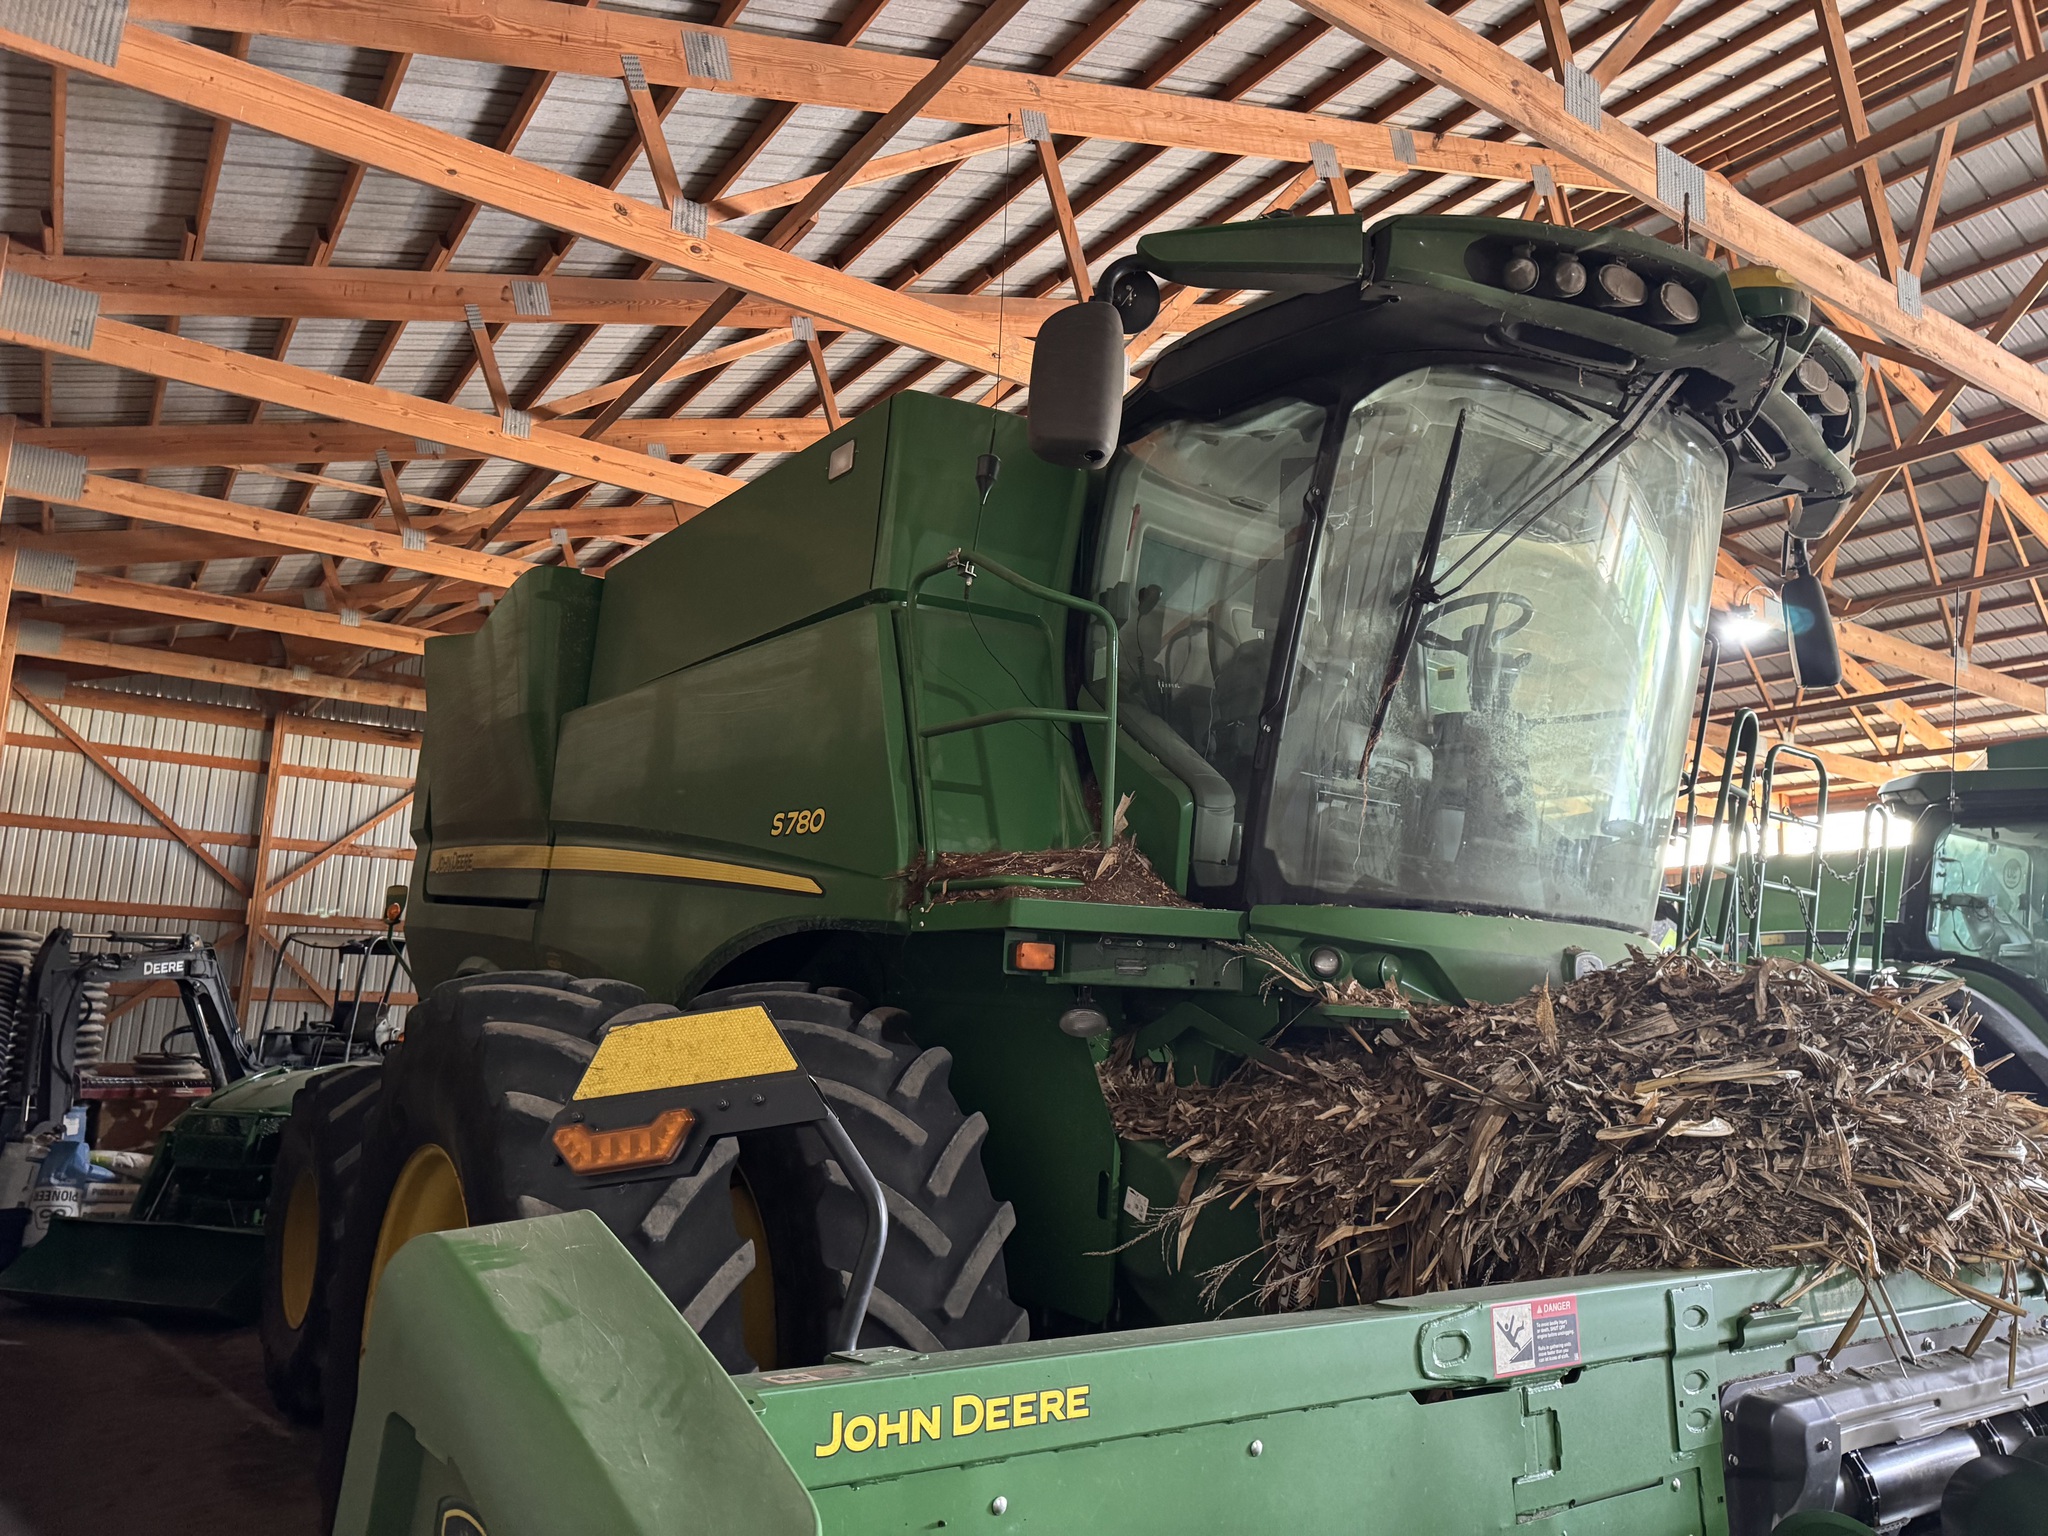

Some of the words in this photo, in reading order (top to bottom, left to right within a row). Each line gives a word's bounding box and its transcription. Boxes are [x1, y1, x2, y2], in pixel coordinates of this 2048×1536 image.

[770, 807, 826, 837] S780
[452, 851, 474, 872] DEERE
[143, 960, 185, 976] DEERE
[1543, 1300, 1571, 1313] DANGER
[814, 1404, 942, 1458] JOHN
[952, 1383, 1091, 1437] DEERE
